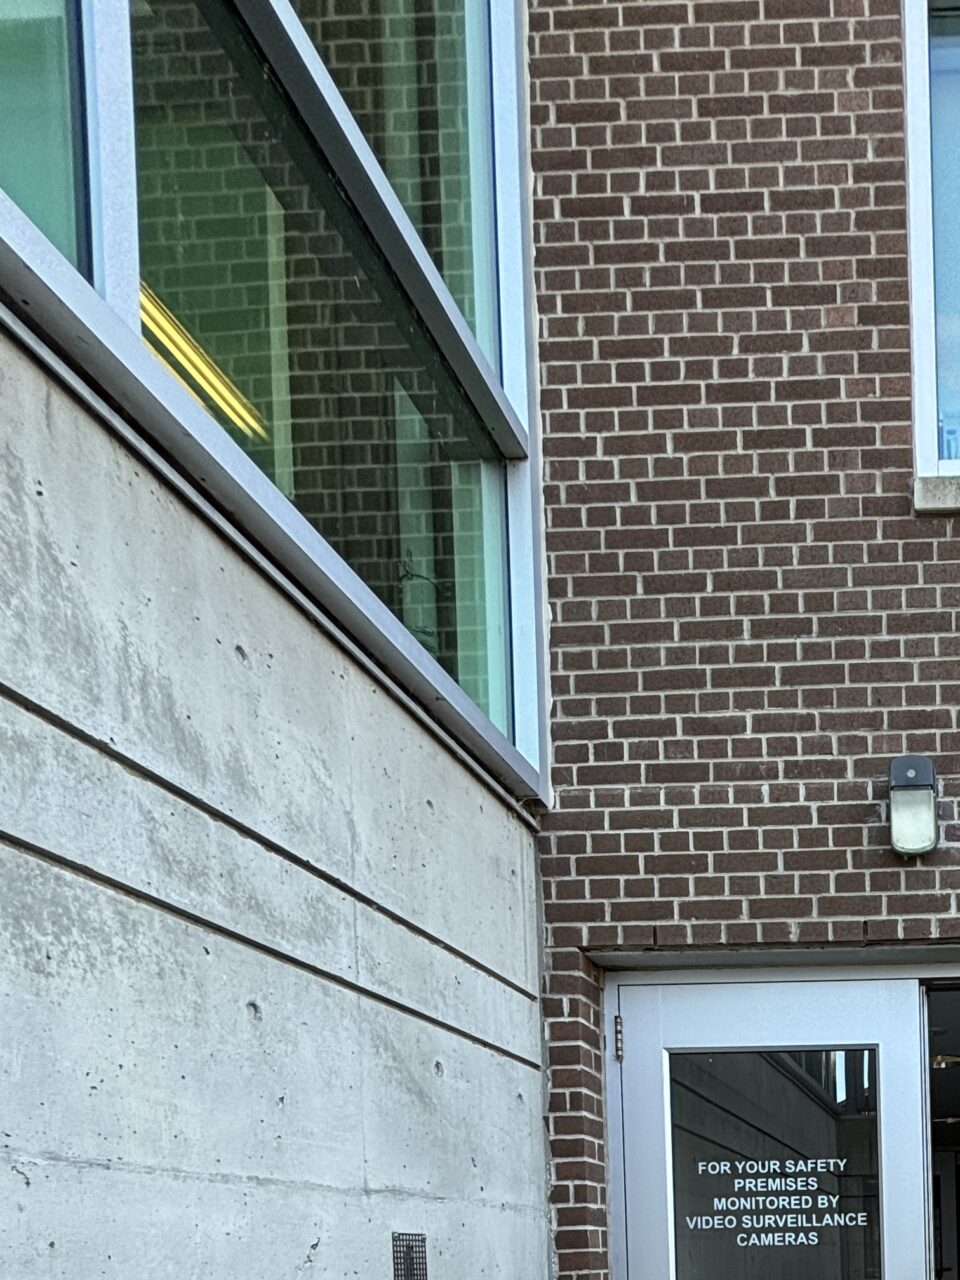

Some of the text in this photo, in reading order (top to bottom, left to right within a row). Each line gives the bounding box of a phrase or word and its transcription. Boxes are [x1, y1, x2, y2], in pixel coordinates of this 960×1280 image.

[698, 1159, 847, 1174] FOR YOUR SAFETY
[734, 1177, 818, 1192] PREMISES
[713, 1195, 840, 1211] MONITORED BY
[686, 1212, 868, 1229] VIDEO SURVEILLANCE
[737, 1232, 819, 1246] CAMERAS
